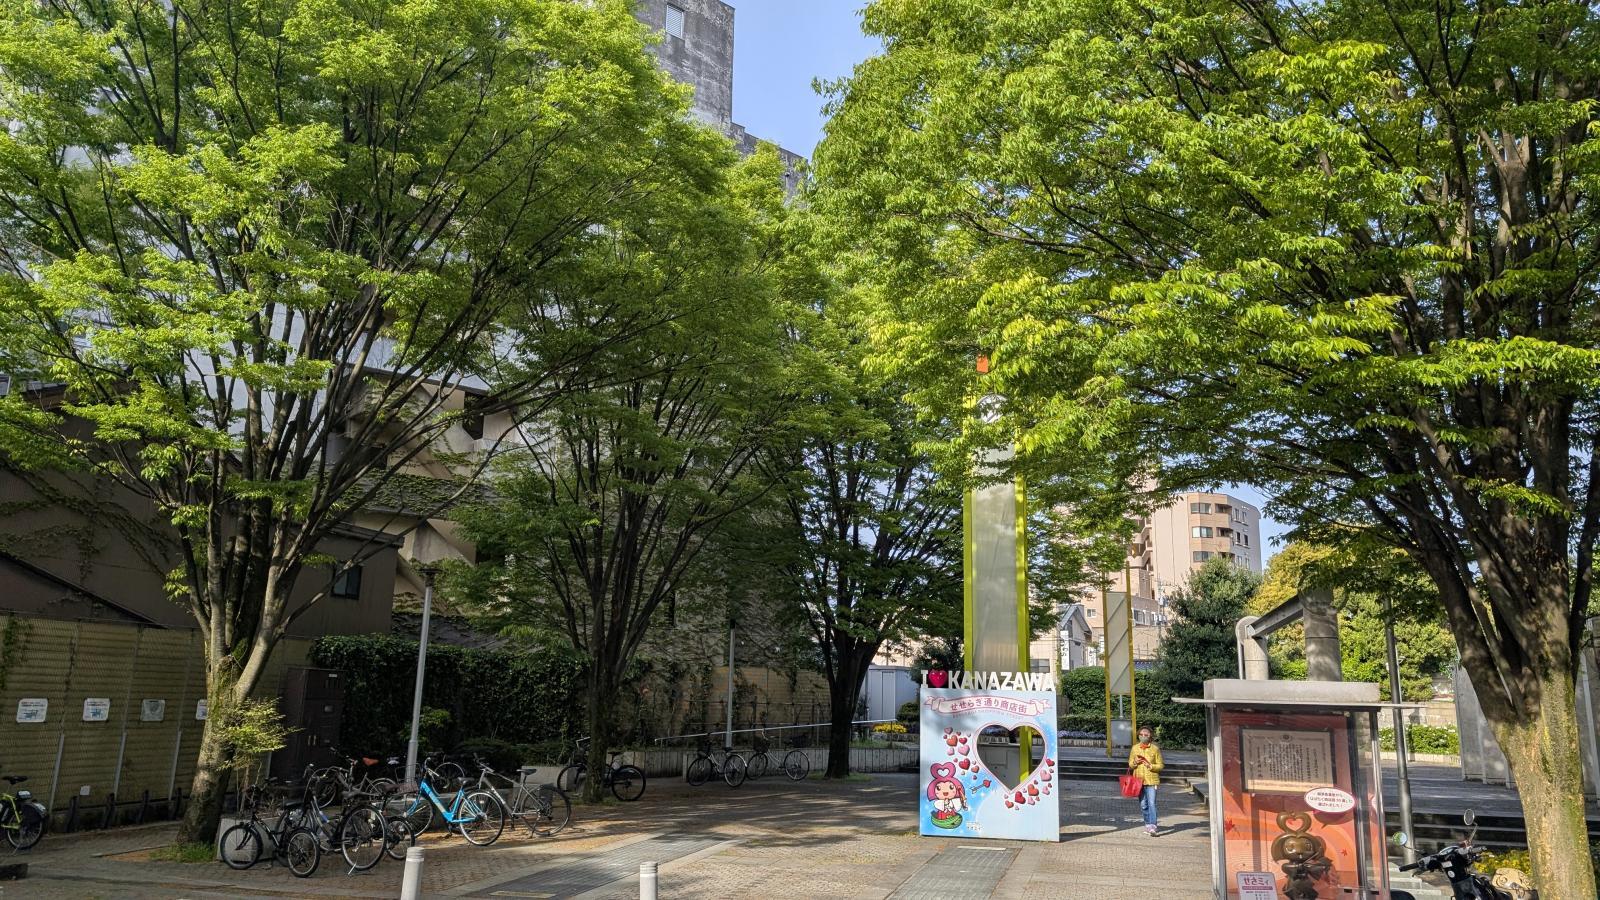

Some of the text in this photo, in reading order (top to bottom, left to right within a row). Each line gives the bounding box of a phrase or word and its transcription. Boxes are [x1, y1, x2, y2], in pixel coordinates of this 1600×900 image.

[920, 670, 1056, 692] I KANAZAWA
[950, 697, 1028, 713] せせらぎ通り商店街
